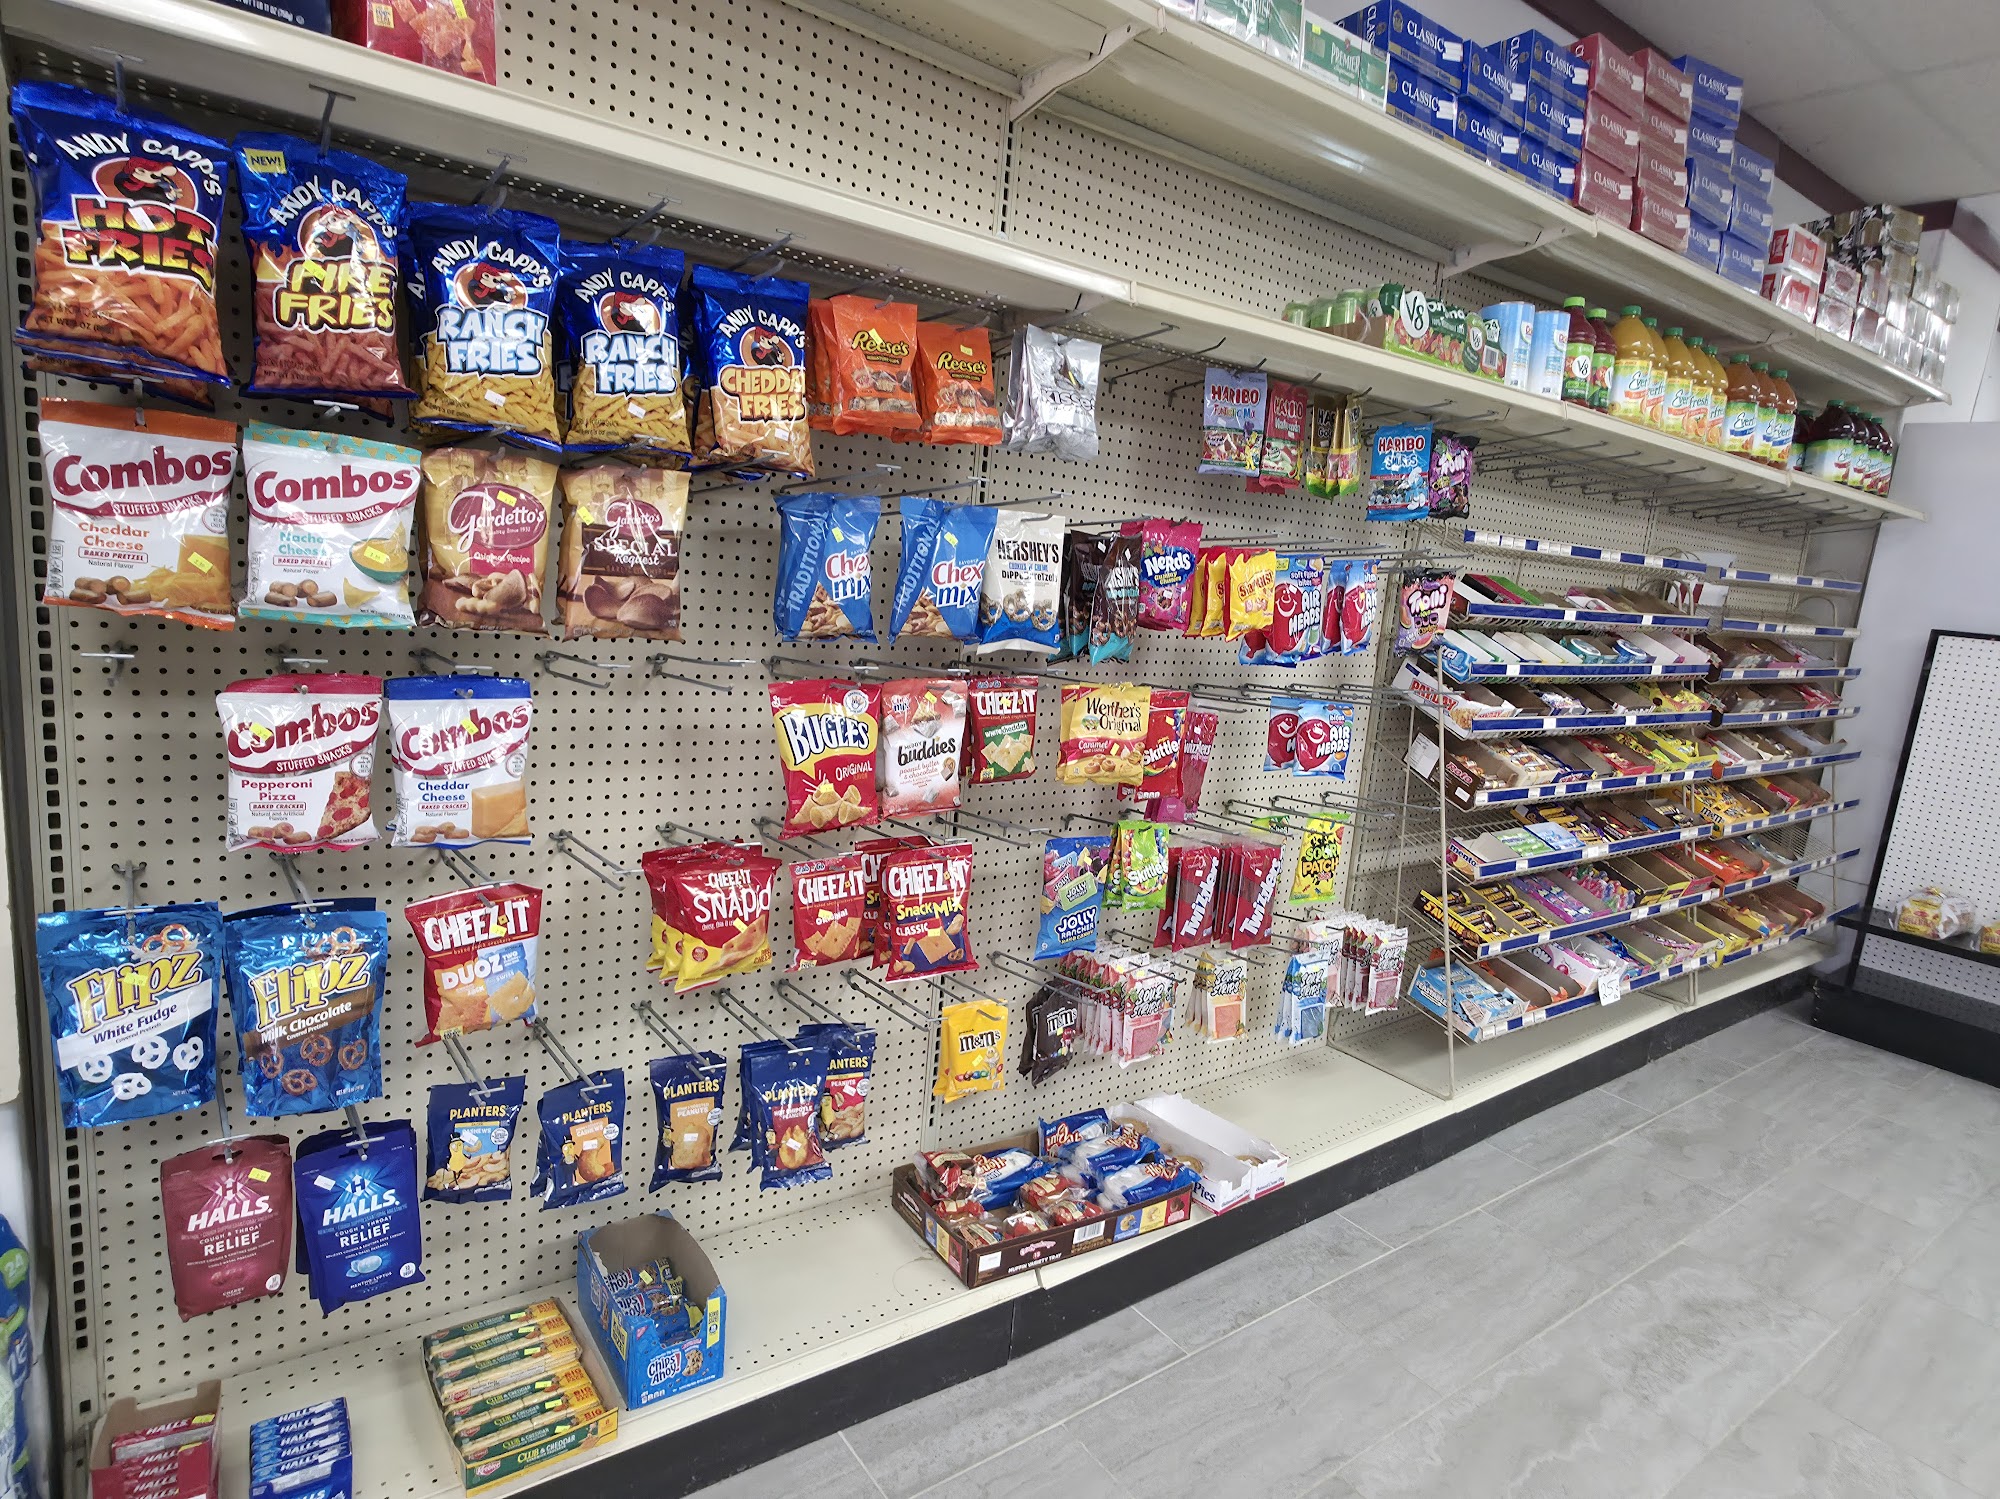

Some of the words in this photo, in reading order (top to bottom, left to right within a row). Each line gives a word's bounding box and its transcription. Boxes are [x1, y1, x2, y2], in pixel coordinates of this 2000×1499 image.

[1407, 20, 1445, 53] CLASSIC
[1331, 42, 1360, 74] PREMIER
[1546, 49, 1575, 78] CLASSIC
[1483, 63, 1512, 95] CLASSIC
[1699, 74, 1728, 94] CLASSIC
[1402, 80, 1440, 112] CLASSIC
[1540, 101, 1569, 129] CLASSIC
[1471, 119, 1504, 148] CLASSIC
[56, 132, 129, 160] ANDY
[251, 154, 282, 168] NEW!
[1532, 152, 1561, 178] CLASSIC
[1594, 171, 1620, 195] CLASSIC
[269, 176, 323, 225] ANDY
[78, 198, 213, 243] HOT
[64, 229, 213, 290] FRIES
[431, 236, 478, 271] ANDY
[575, 268, 614, 303] ANDY
[281, 293, 394, 327] FRIES
[719, 305, 754, 338] ANDY
[1405, 295, 1425, 331] V8
[438, 309, 545, 341] RANCH
[448, 342, 540, 374] FRIES
[585, 334, 676, 365] RANCH
[1577, 359, 1590, 375] V8
[600, 365, 675, 393] FRIES
[741, 394, 805, 418] FRIES
[1211, 384, 1260, 405] HARIBO
[1378, 436, 1426, 453] HARIBO
[53, 446, 232, 496] Combos
[255, 465, 413, 508] Combos
[113, 501, 160, 515] STUFFED
[162, 494, 203, 513] SNACKS
[346, 504, 384, 522] SNACKS
[78, 522, 150, 538] Cheddar
[279, 531, 325, 545] Nacho
[84, 535, 144, 551] Cheese
[594, 537, 678, 557] SPECIAL
[997, 540, 1060, 563] HERSHEY'S
[84, 549, 110, 558] BAKED
[112, 552, 144, 562] PRETZEL
[507, 552, 531, 565] Recipe
[615, 553, 659, 567] Request
[788, 508, 829, 612] TRADITIONAL
[892, 517, 940, 614] TRADITIONAL
[932, 561, 983, 585] Chex
[832, 575, 871, 601] mix
[936, 584, 978, 608] mix
[1302, 590, 1320, 608] AIR
[1408, 583, 1448, 616] Trolli
[1289, 608, 1320, 636] HEADS
[1086, 697, 1142, 718] Werther's
[226, 701, 379, 759] Combos
[400, 705, 529, 760] Combos
[1100, 713, 1142, 736] Original
[1330, 725, 1350, 740] AIR
[782, 712, 869, 765] BUGLES
[1078, 740, 1110, 751] Caramel
[1317, 738, 1349, 757] HEADS
[276, 759, 315, 772] STUFFED
[318, 744, 352, 765] SNACKS
[897, 737, 956, 767] buddies
[443, 759, 476, 775] STUFFED
[836, 760, 872, 781] ORIGINAL
[1446, 761, 1473, 784] Rolo
[241, 778, 313, 791] Pepperoni
[259, 791, 296, 801] Pizza
[418, 781, 469, 791] Cheddar
[276, 802, 304, 810] CRACKER
[422, 792, 466, 802] Cheese
[1305, 843, 1339, 861] SOUR
[1449, 844, 1477, 867] mento
[1302, 857, 1339, 877] PATCH
[1054, 873, 1071, 892] JOLLY
[1067, 880, 1087, 897] JOLLY
[897, 902, 932, 921] Snack
[933, 897, 964, 918] Mix
[1058, 908, 1096, 933] JOLLY
[896, 922, 928, 936] CLASSIC
[1062, 923, 1095, 939] RANCHER
[503, 950, 518, 960] TWO
[442, 953, 503, 990] DUOZ
[1215, 966, 1241, 983] SOUR
[1301, 970, 1323, 990] SOUR
[70, 951, 203, 1033] Flipz
[251, 952, 370, 1030] Flipz
[1137, 983, 1162, 1006] SOUR
[1211, 980, 1239, 997] STRIPS
[93, 1019, 134, 1044] White
[137, 1003, 178, 1028] Fudge
[261, 1021, 287, 1044] Milk
[289, 1001, 352, 1030] Chocolate
[287, 1028, 310, 1041] Covered
[664, 1080, 719, 1099] PLANTERS
[765, 1083, 818, 1103] PLANTERS
[451, 1105, 507, 1121] PLANTERS
[562, 1102, 613, 1125] PLANTERS
[677, 1106, 709, 1117] PEANUTS
[200, 1234, 225, 1245] COUGH
[235, 1223, 262, 1235] THROAT
[335, 1227, 358, 1238] COUGH
[368, 1216, 392, 1228] THROAT
[340, 1223, 390, 1248] RELIEF
[204, 1231, 260, 1257] RELIEF
[1008, 1261, 1027, 1274] MUFFIN
[1027, 1257, 1048, 1269] VARIETY
[649, 1355, 676, 1377] Chips
[147, 1419, 189, 1435] HALLS
[281, 1440, 320, 1457] HALLS
[518, 1447, 540, 1463] CLUB
[546, 1435, 576, 1453] CHEDDAR
